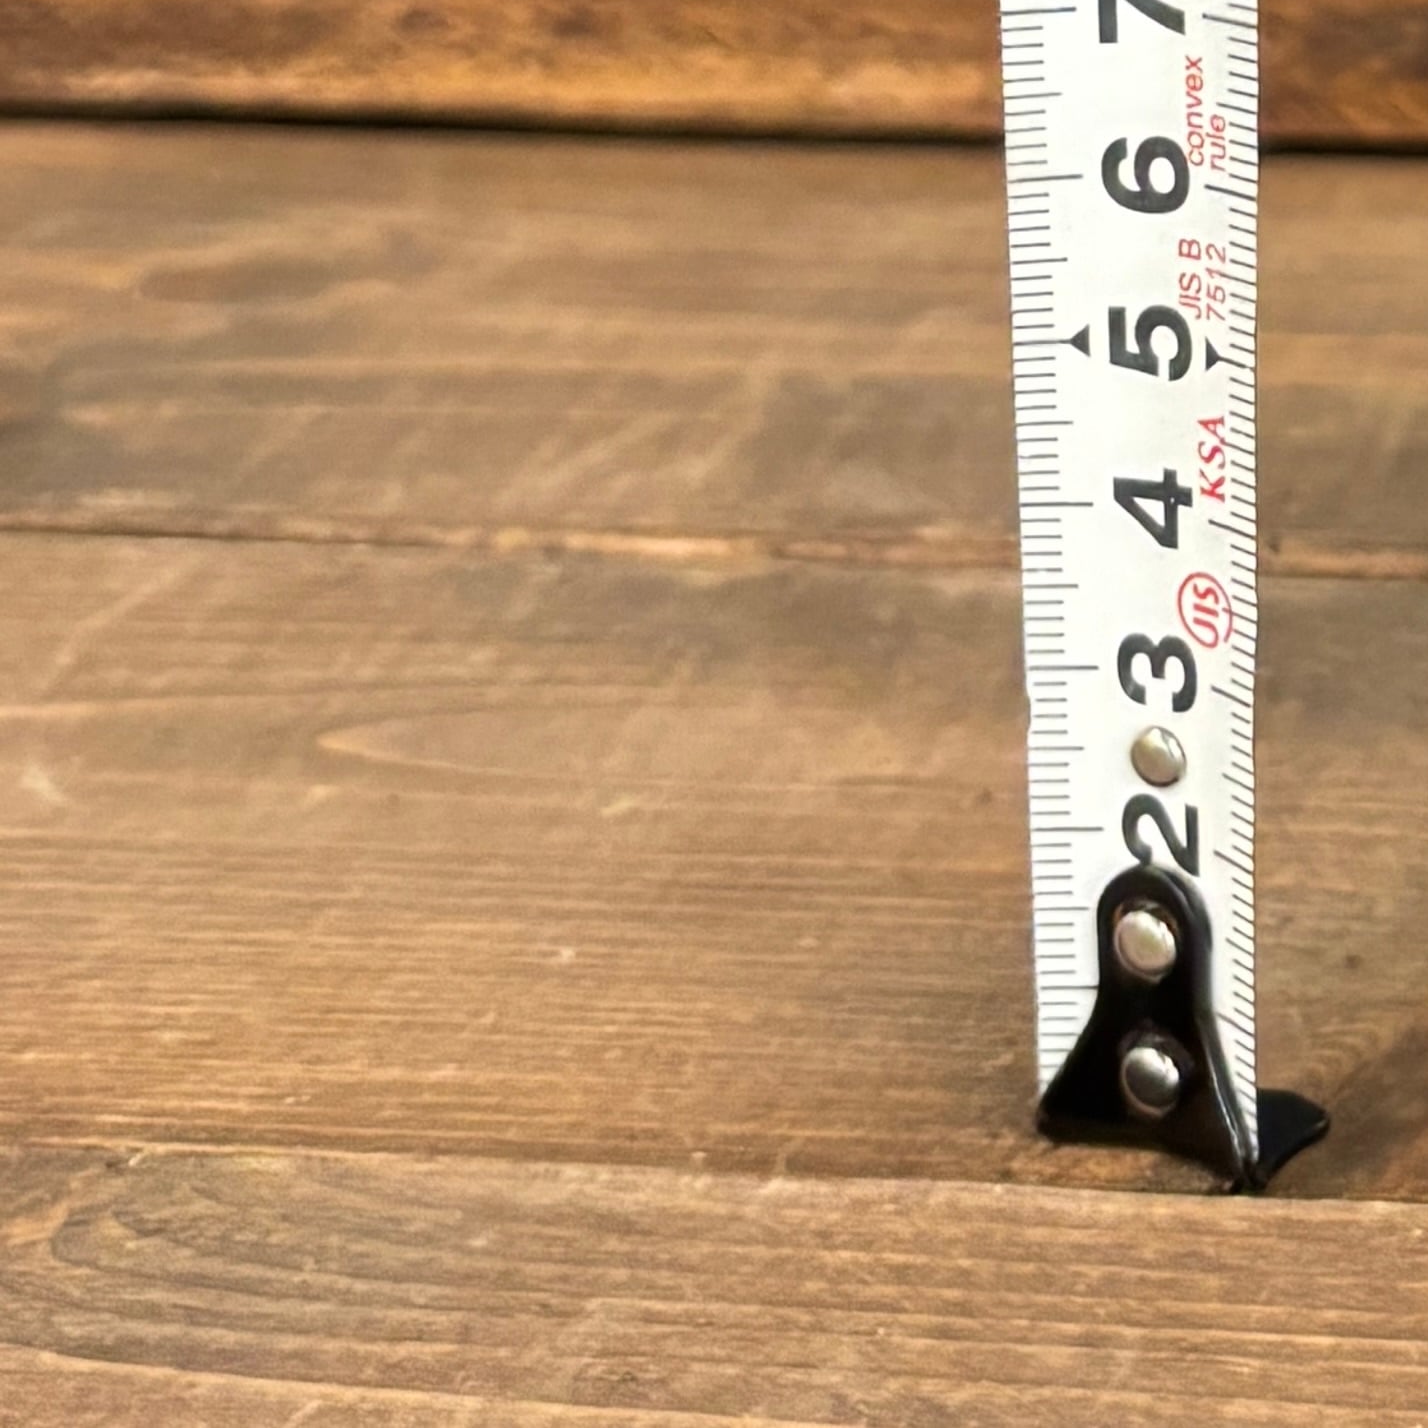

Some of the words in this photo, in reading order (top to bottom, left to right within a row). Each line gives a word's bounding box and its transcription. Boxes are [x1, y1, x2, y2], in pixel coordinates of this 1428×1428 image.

[1184, 55, 1204, 167] convex
[1206, 113, 1227, 173] rule
[1101, 136, 1190, 215] 6
[1179, 238, 1201, 263] B
[1206, 242, 1227, 323] 7512
[1178, 272, 1202, 320] JIS
[1108, 304, 1193, 382] 5
[1199, 414, 1226, 502] KSA
[1113, 468, 1193, 549] 4
[1117, 633, 1198, 713] 3
[1122, 793, 1200, 877] 2
